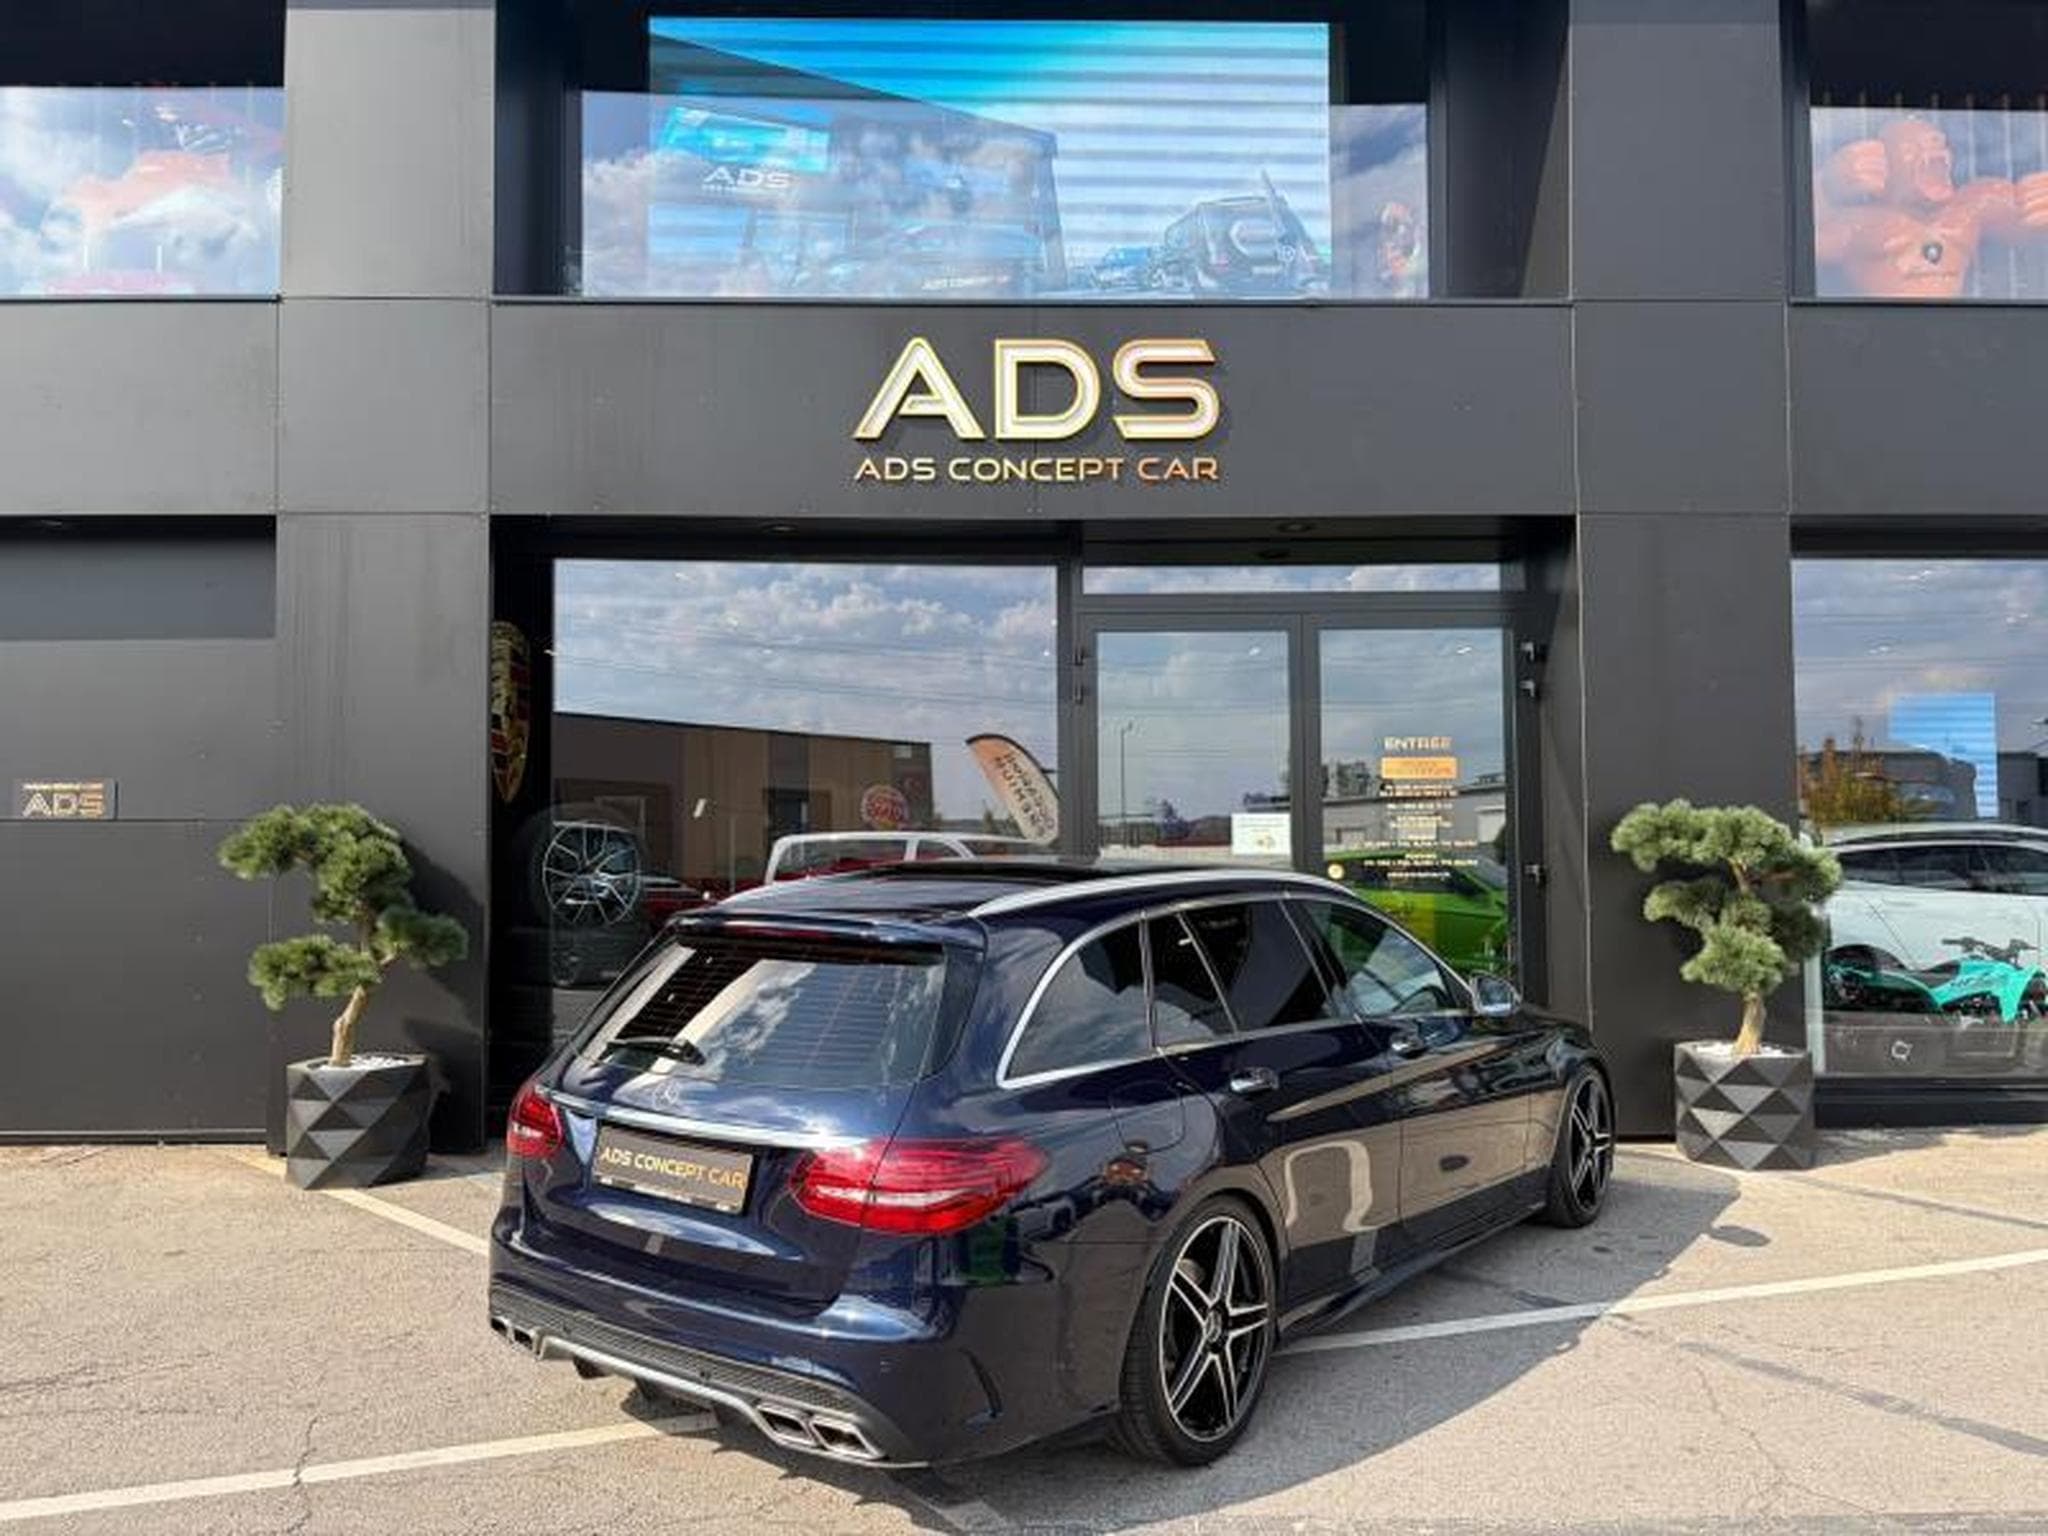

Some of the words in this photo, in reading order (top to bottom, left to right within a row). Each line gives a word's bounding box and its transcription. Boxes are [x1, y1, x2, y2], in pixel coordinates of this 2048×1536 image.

[703, 166, 791, 189] ADS
[853, 336, 1221, 440] ADS
[853, 457, 937, 482] ADS
[948, 457, 1124, 482] CONCEPT
[1136, 457, 1220, 482] CAR
[22, 792, 104, 817] ADS
[600, 1147, 632, 1168] ADS
[634, 1153, 707, 1180] CONCEPT
[708, 1167, 747, 1190] CAR
